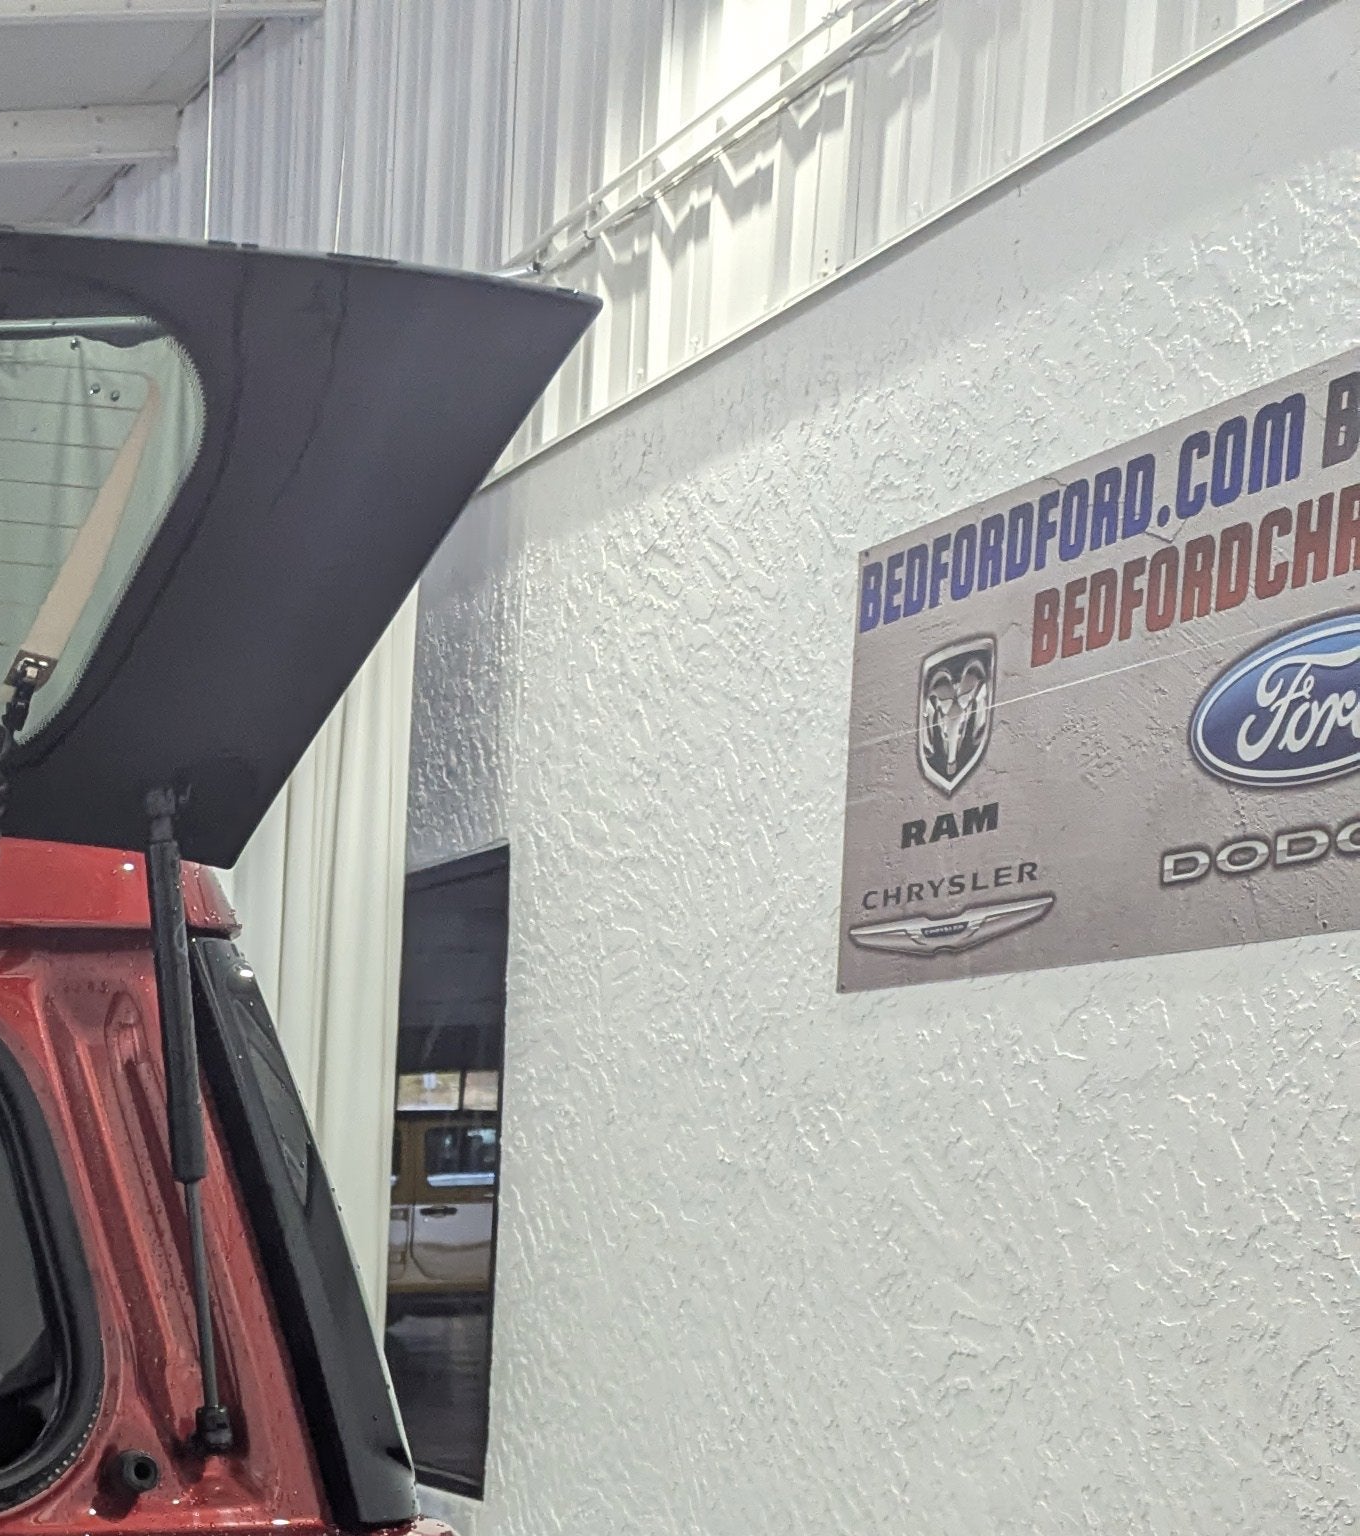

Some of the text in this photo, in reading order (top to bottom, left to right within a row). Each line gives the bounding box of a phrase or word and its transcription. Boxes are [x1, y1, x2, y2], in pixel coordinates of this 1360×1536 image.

[858, 392, 1307, 634] BEDFORDFORD.COM
[900, 801, 1000, 850] RAM
[861, 861, 1039, 911] CHRYSLER
